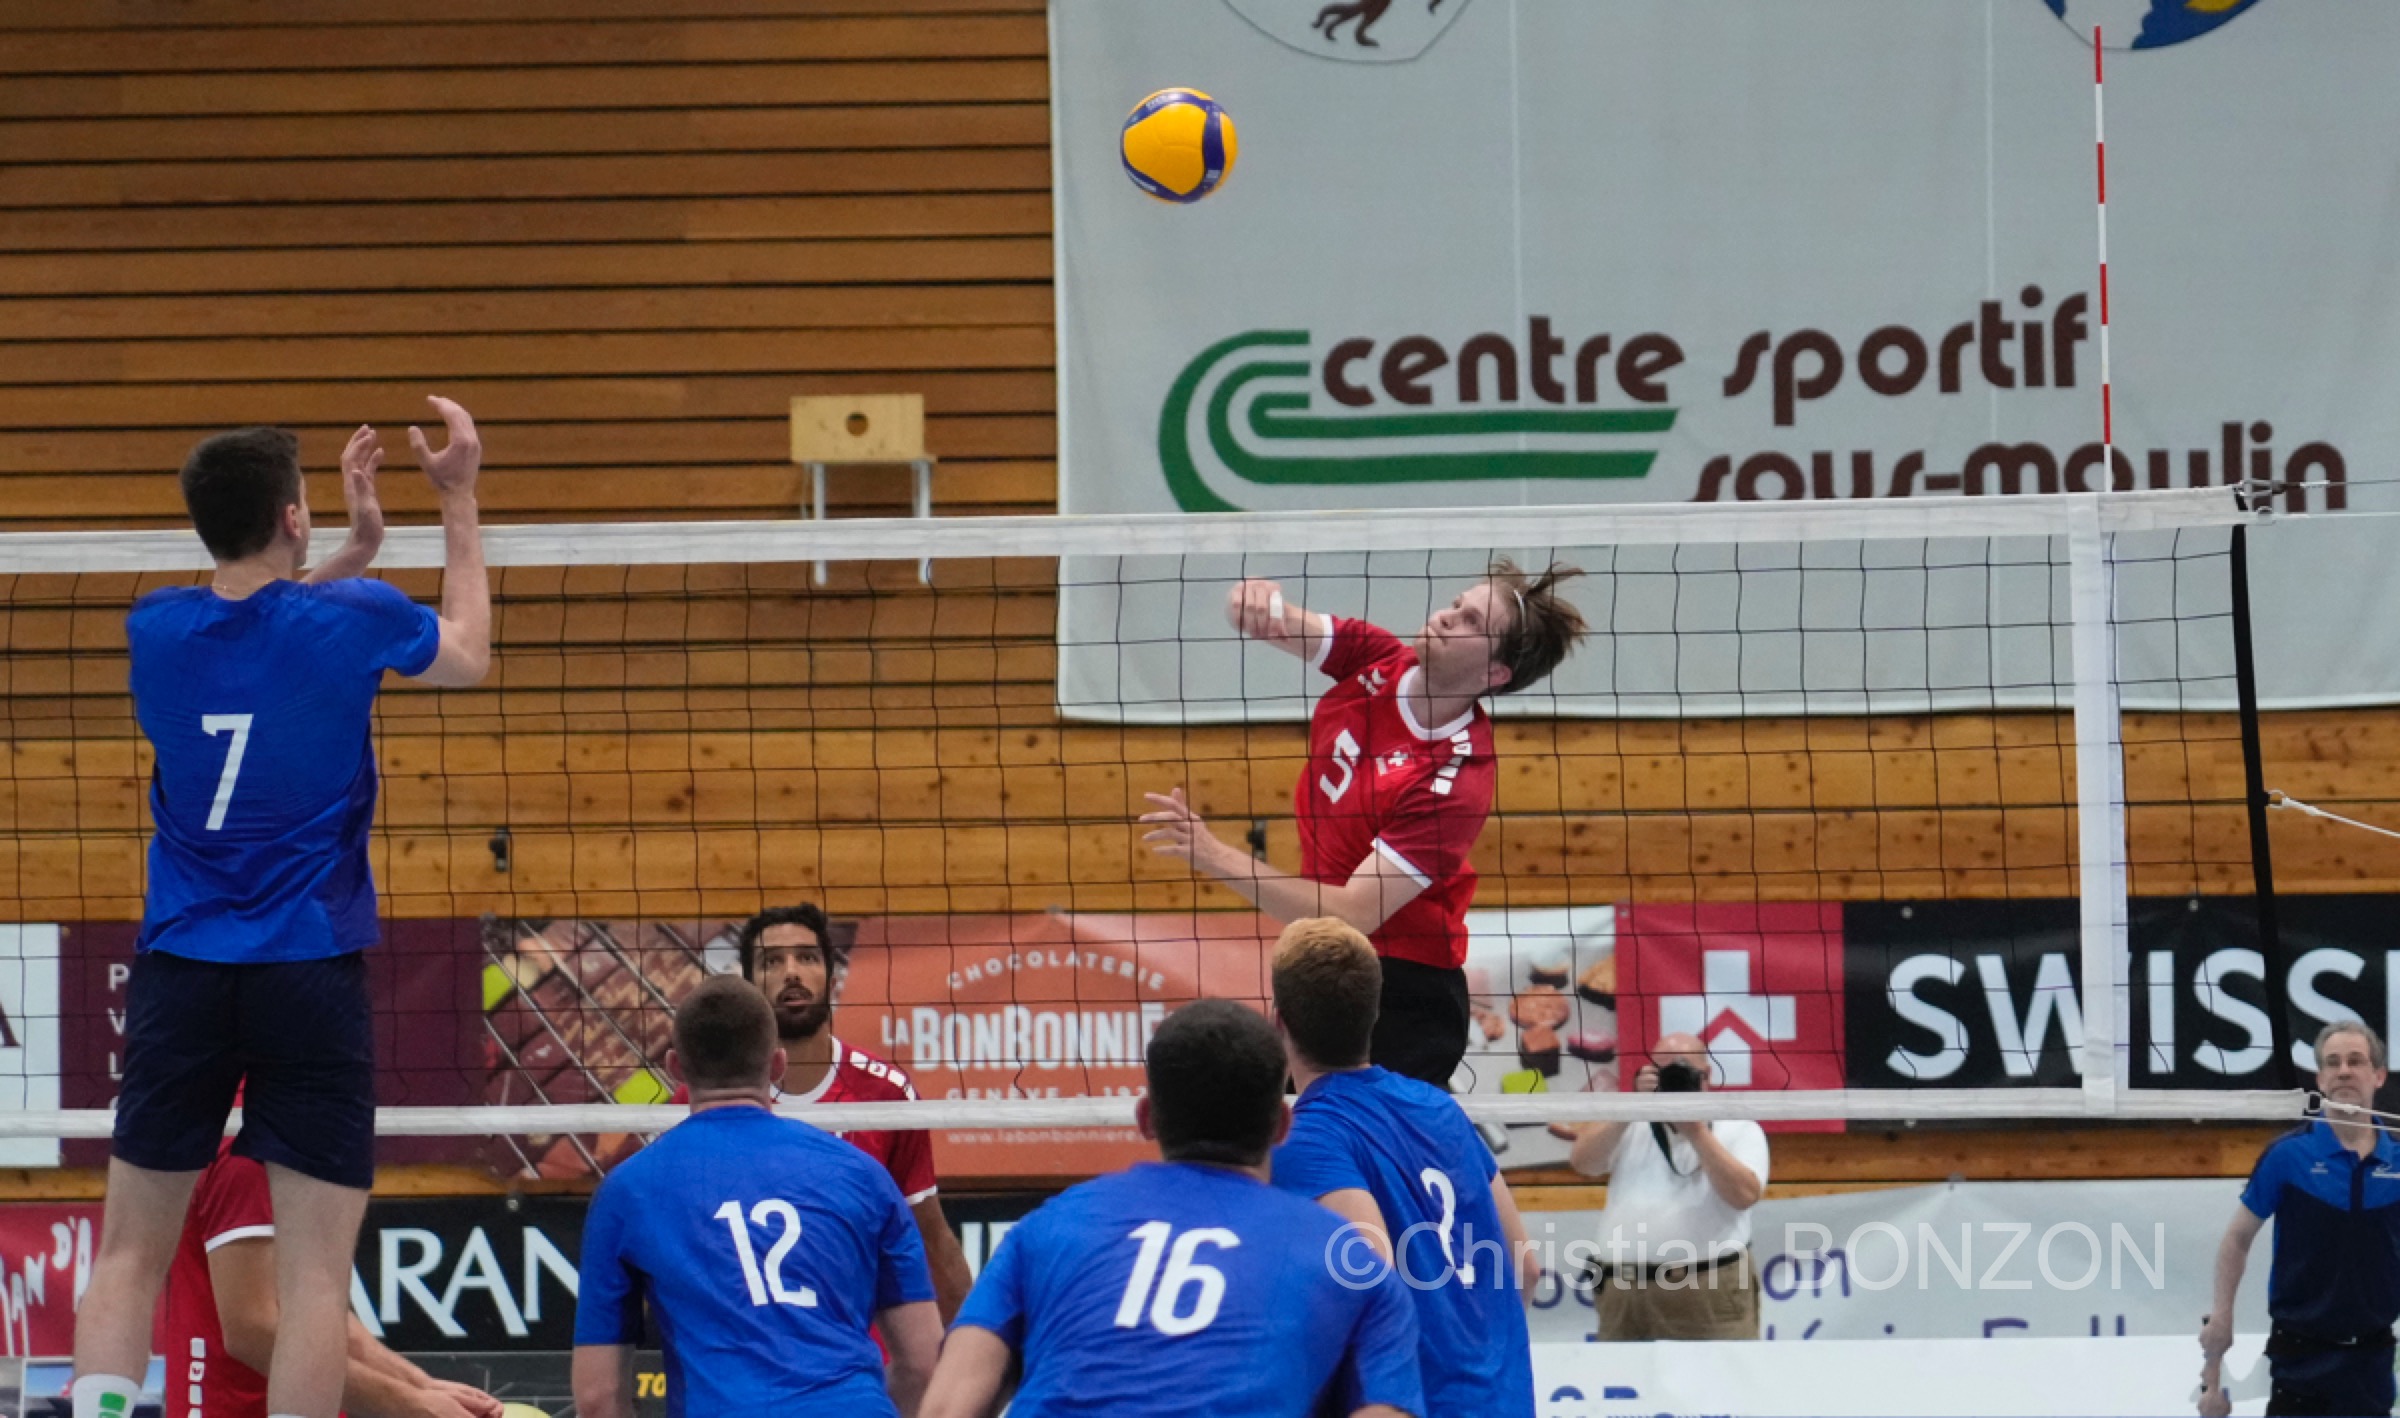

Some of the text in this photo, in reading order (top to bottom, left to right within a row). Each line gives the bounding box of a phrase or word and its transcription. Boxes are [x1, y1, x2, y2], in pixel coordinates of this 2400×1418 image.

[1322, 285, 2088, 427] centre sportif
[201, 713, 253, 831] 7
[1319, 728, 1361, 804] 5
[946, 949, 1165, 991] CHOCOLATERIE
[1885, 947, 2400, 1079] SWISS
[713, 1199, 817, 1307] 12
[1113, 1220, 1241, 1336] 16
